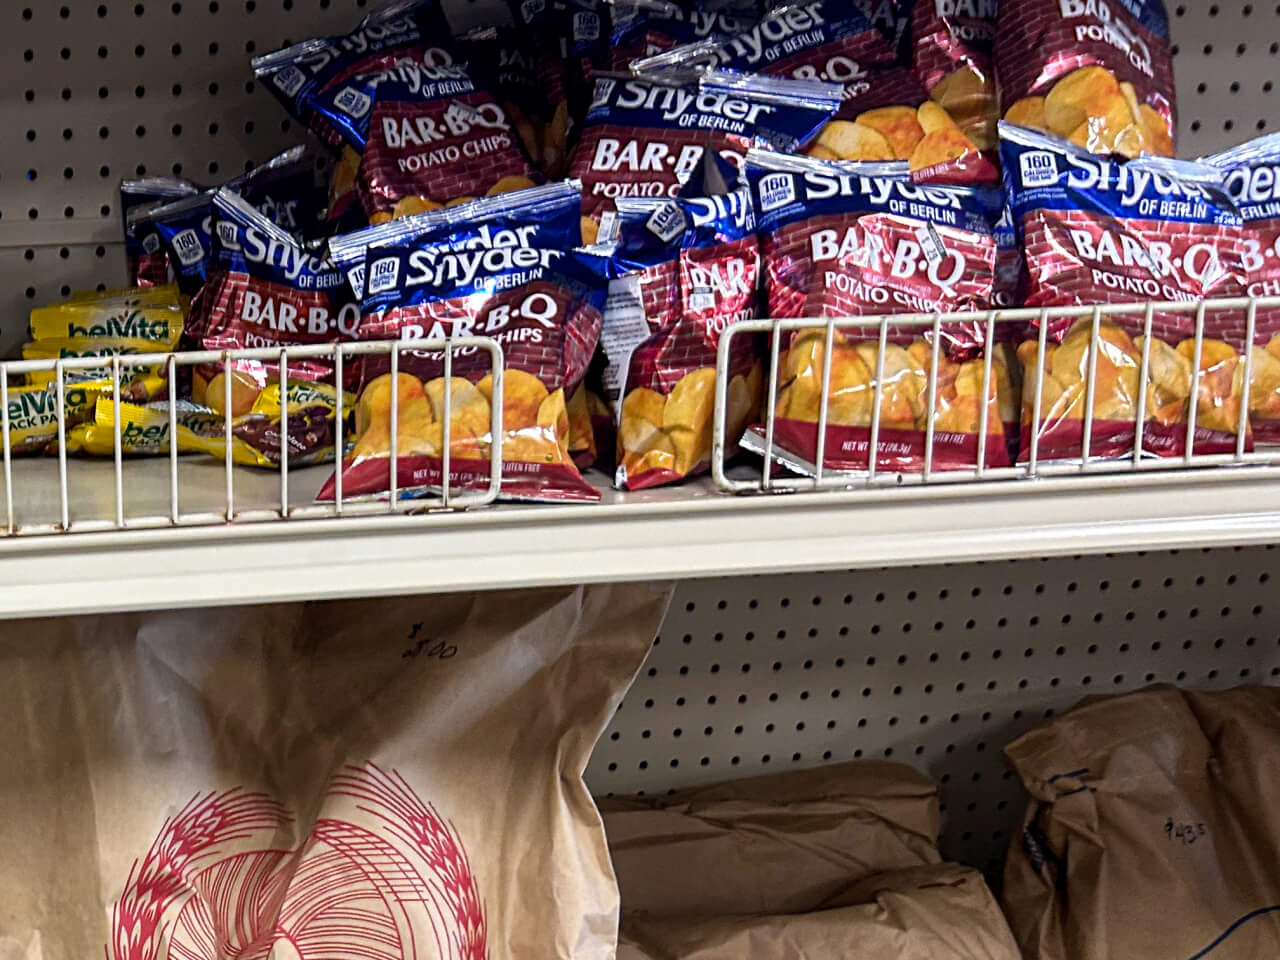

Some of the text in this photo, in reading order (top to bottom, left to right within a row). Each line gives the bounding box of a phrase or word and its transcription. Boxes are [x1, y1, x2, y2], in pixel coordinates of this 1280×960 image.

[765, 30, 826, 61] OF BERLIN
[422, 82, 436, 97] OF
[616, 80, 776, 124] Snyder
[678, 112, 745, 133] OF BERLIN
[398, 133, 512, 173] POTATO CHIPS
[1024, 154, 1051, 168] 160
[592, 182, 665, 198] POTATO
[762, 175, 789, 193] 160
[889, 199, 957, 226] OF BERLIN
[1139, 198, 1157, 216] OF
[1159, 199, 1208, 219] BERLIN
[175, 232, 197, 250] 160
[374, 259, 396, 274] 160
[405, 247, 566, 288] Snyder
[298, 276, 314, 288] OF
[495, 267, 543, 290] BERLIN
[1093, 269, 1160, 296] POTATO
[824, 271, 942, 313] POTATO CHIPS
[67, 310, 169, 340] belVita
[842, 440, 856, 451] NET
